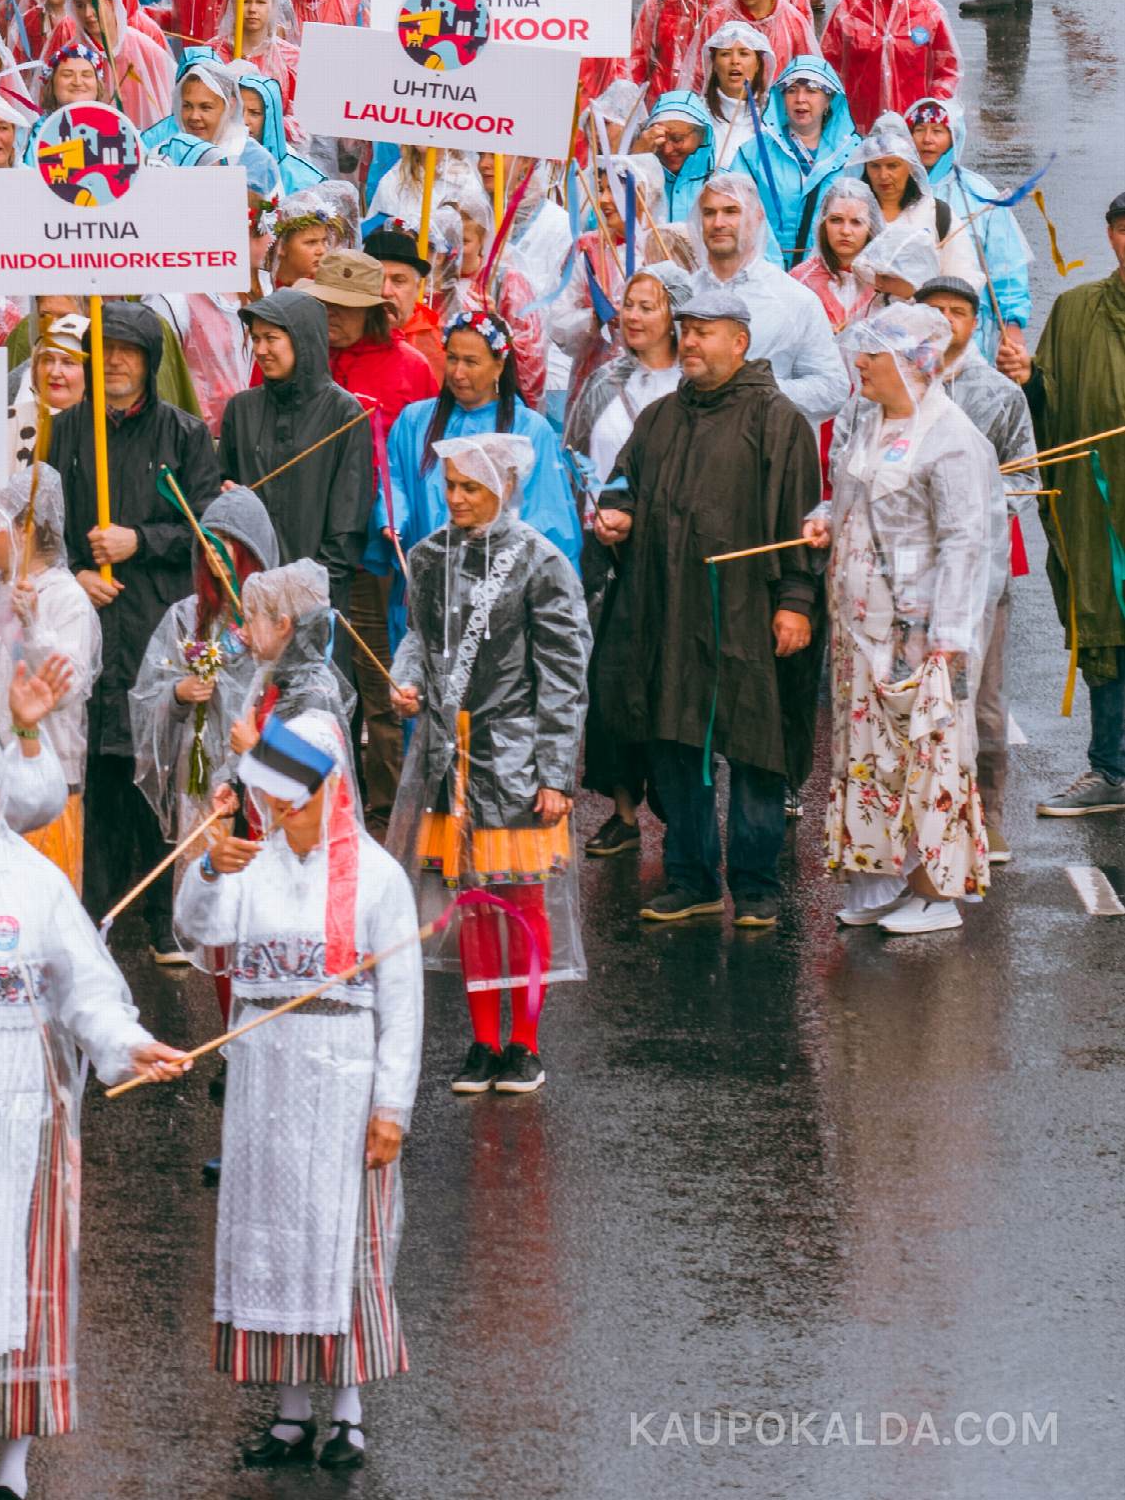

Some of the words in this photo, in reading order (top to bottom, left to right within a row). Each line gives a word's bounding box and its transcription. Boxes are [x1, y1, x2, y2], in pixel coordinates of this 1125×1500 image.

[492, 18, 591, 41] KOOR
[393, 78, 478, 103] UHTNA
[343, 101, 515, 136] LAULUKOOR
[43, 221, 139, 240] UHTNA
